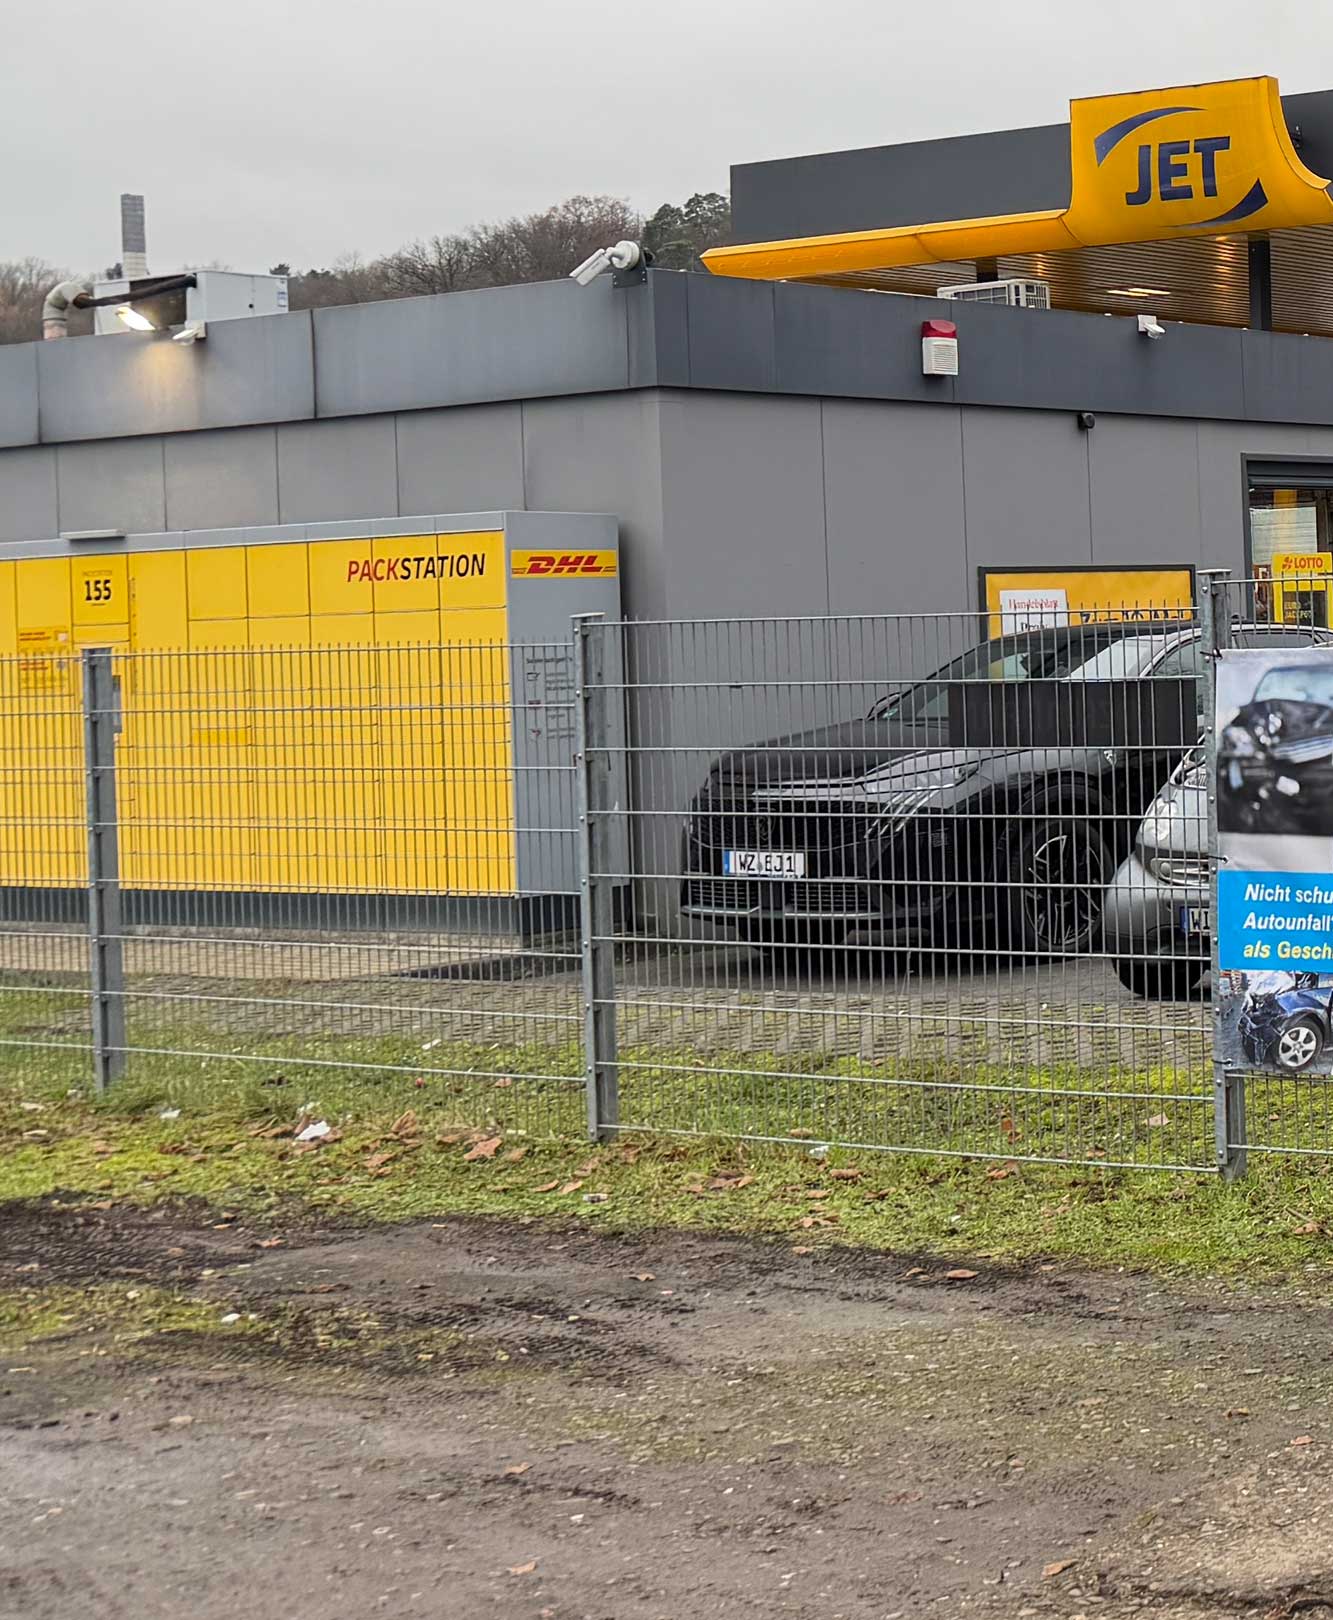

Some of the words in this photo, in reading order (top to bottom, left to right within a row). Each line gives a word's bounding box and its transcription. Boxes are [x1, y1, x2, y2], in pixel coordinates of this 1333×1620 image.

[1125, 136, 1230, 205] JET
[347, 553, 485, 582] PACKSTATION
[527, 556, 603, 574] DHL
[1294, 557, 1323, 569] LOTTO
[85, 580, 112, 601] 155
[739, 854, 756, 871] WZ
[1244, 883, 1290, 902] Nicht
[1243, 940, 1271, 958] als
